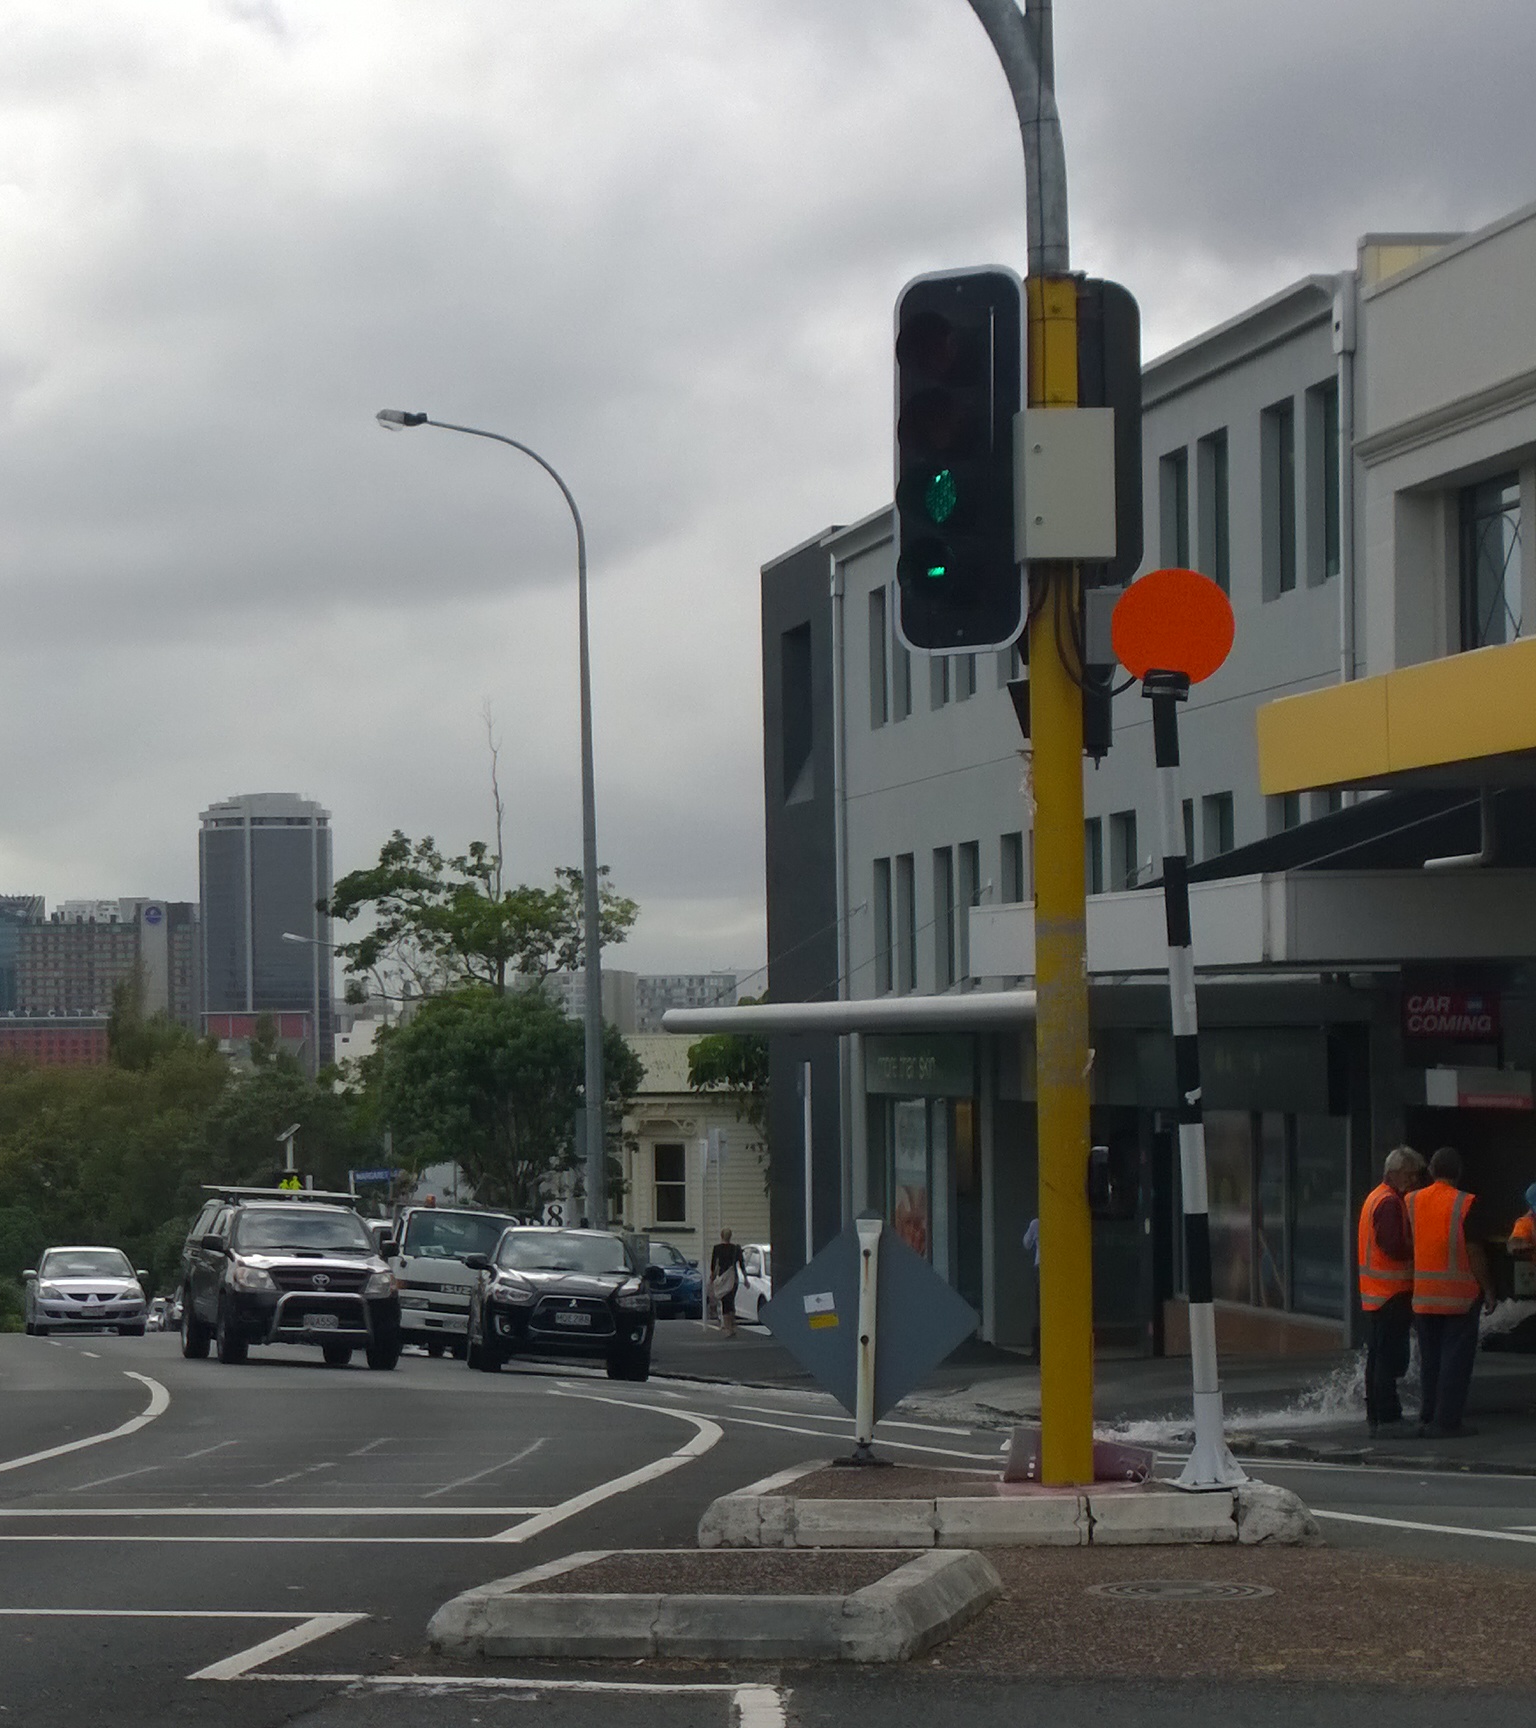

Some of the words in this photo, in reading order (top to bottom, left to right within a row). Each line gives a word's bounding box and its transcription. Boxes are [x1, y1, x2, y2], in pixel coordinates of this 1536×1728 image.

[1407, 996, 1451, 1013] CAR
[1408, 1015, 1492, 1032] COMING
[440, 1284, 472, 1295] ISUZ
